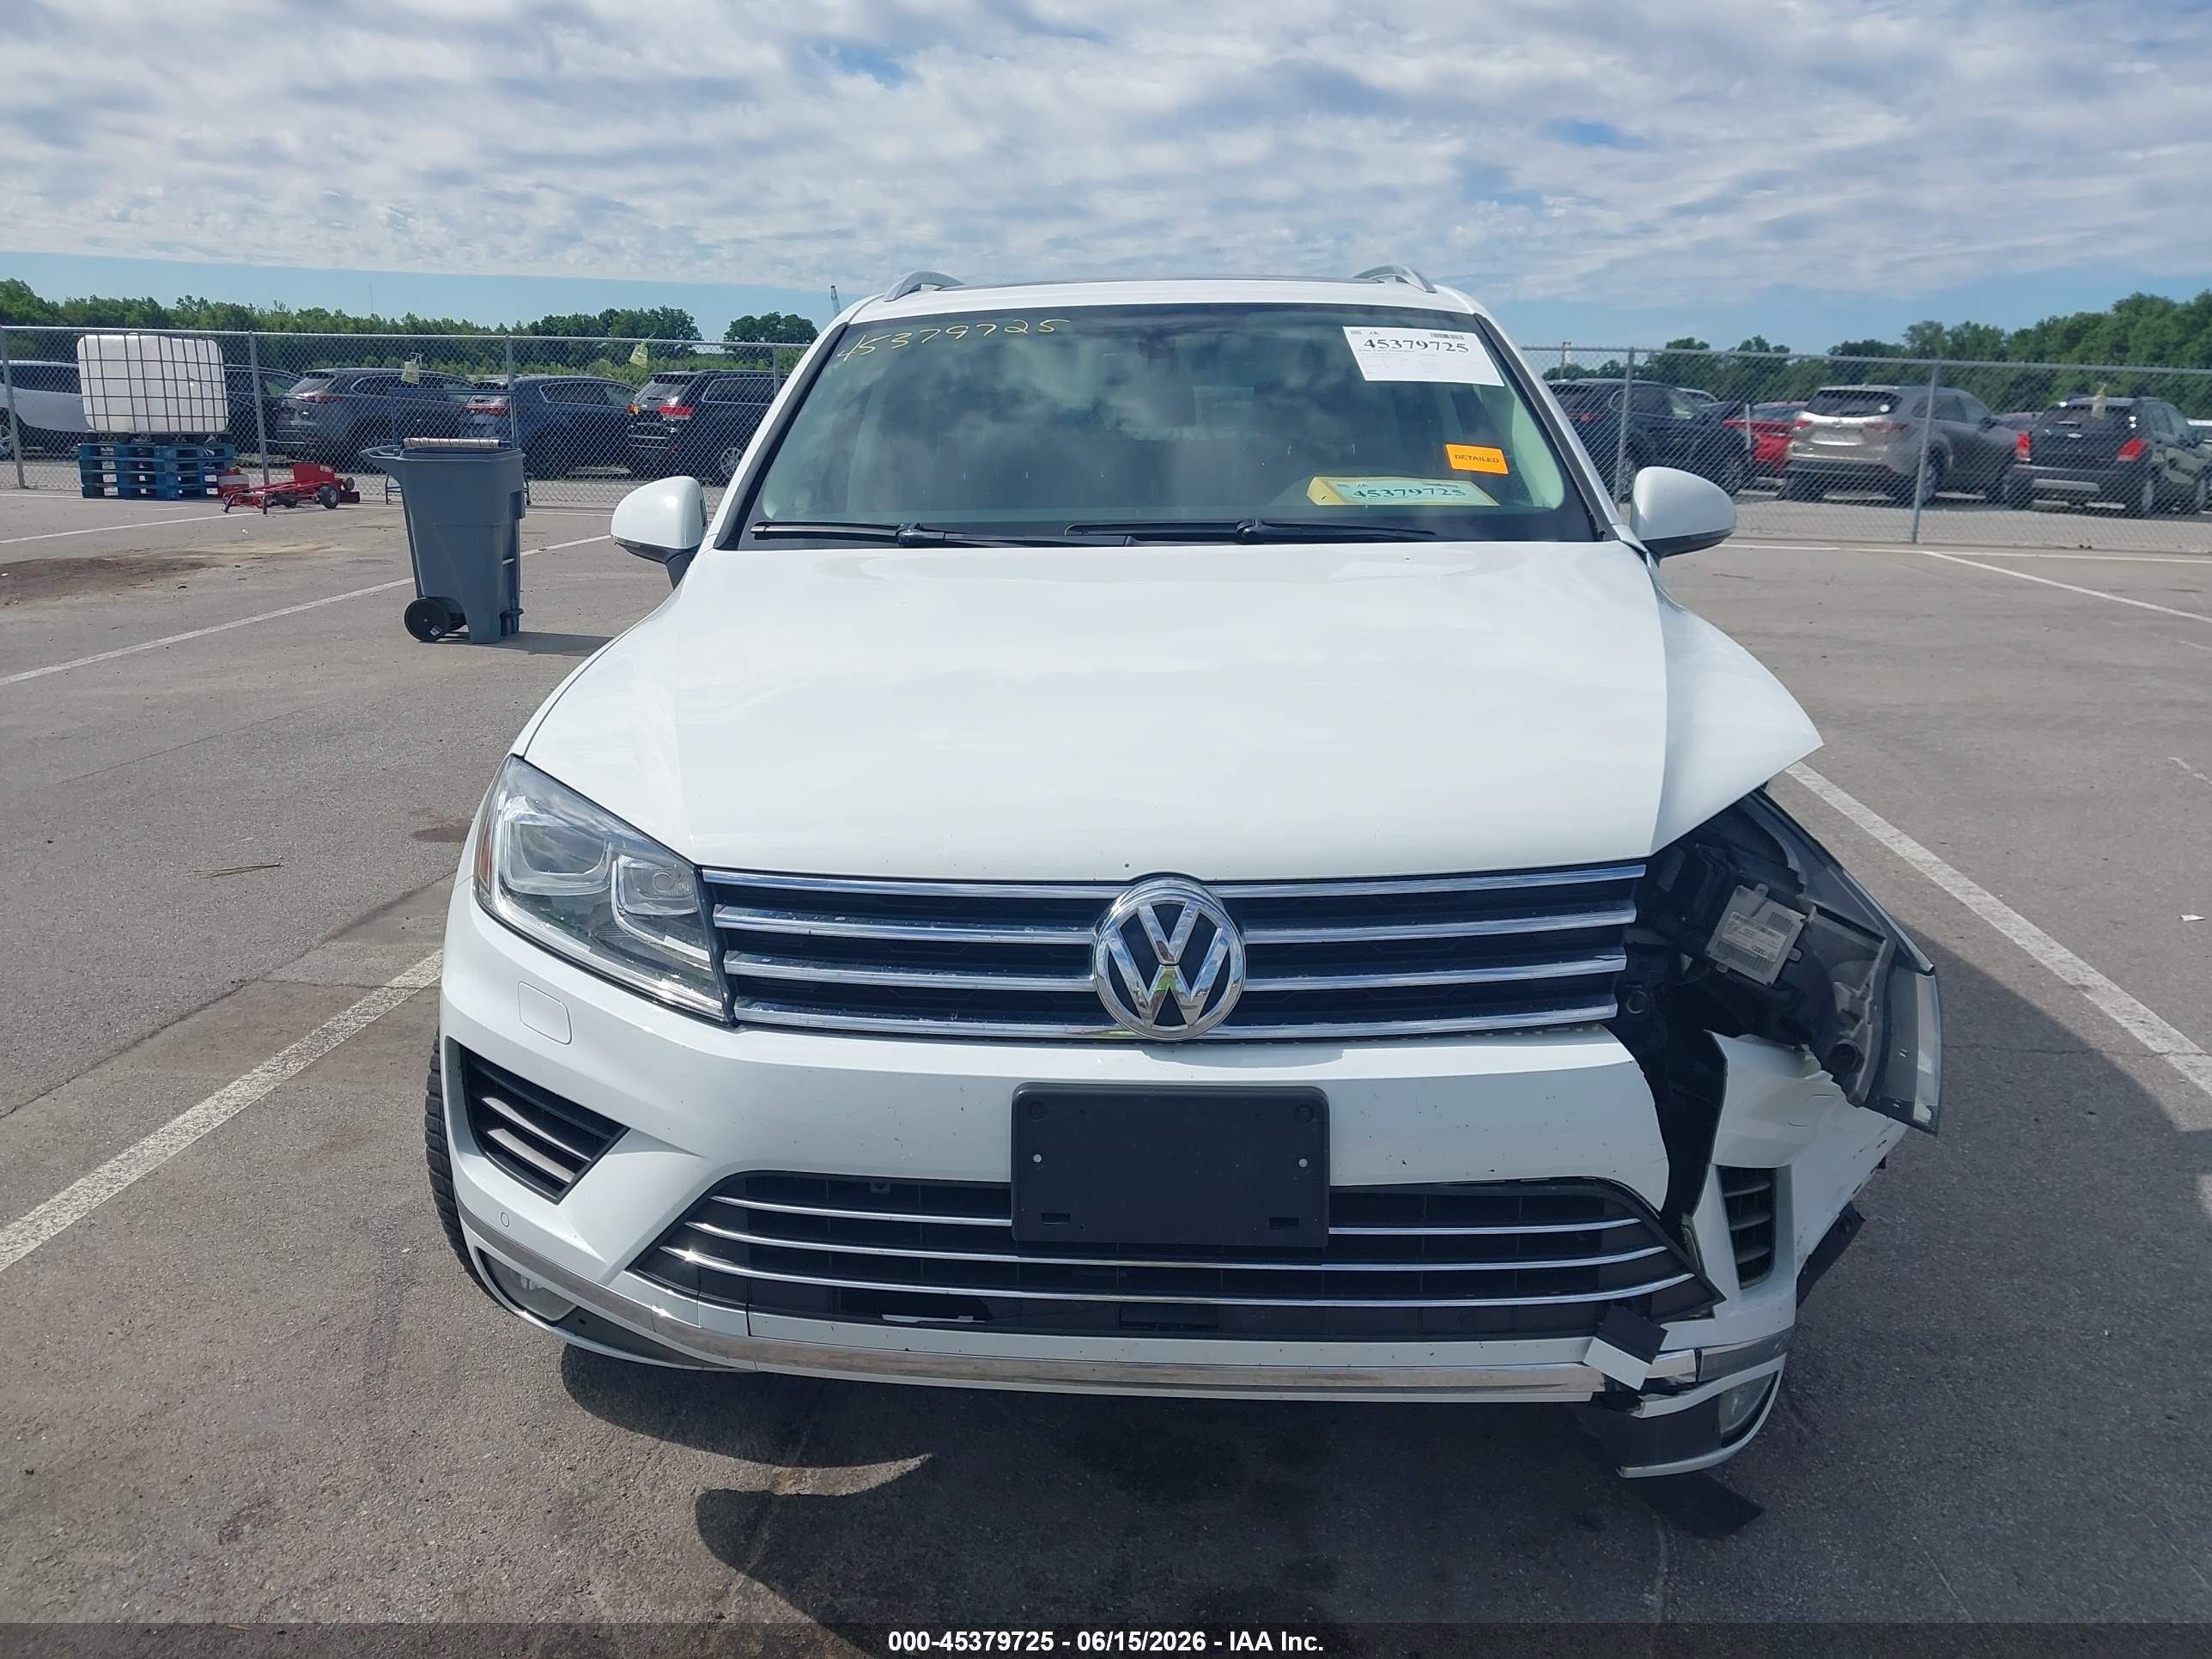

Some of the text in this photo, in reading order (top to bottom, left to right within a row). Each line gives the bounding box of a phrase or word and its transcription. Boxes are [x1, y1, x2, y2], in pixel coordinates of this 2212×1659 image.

[837, 319, 1070, 362] 45379725
[1364, 338, 1469, 353] 45379725
[1455, 453, 1500, 464] DETAILED
[1353, 487, 1466, 499] 45379725
